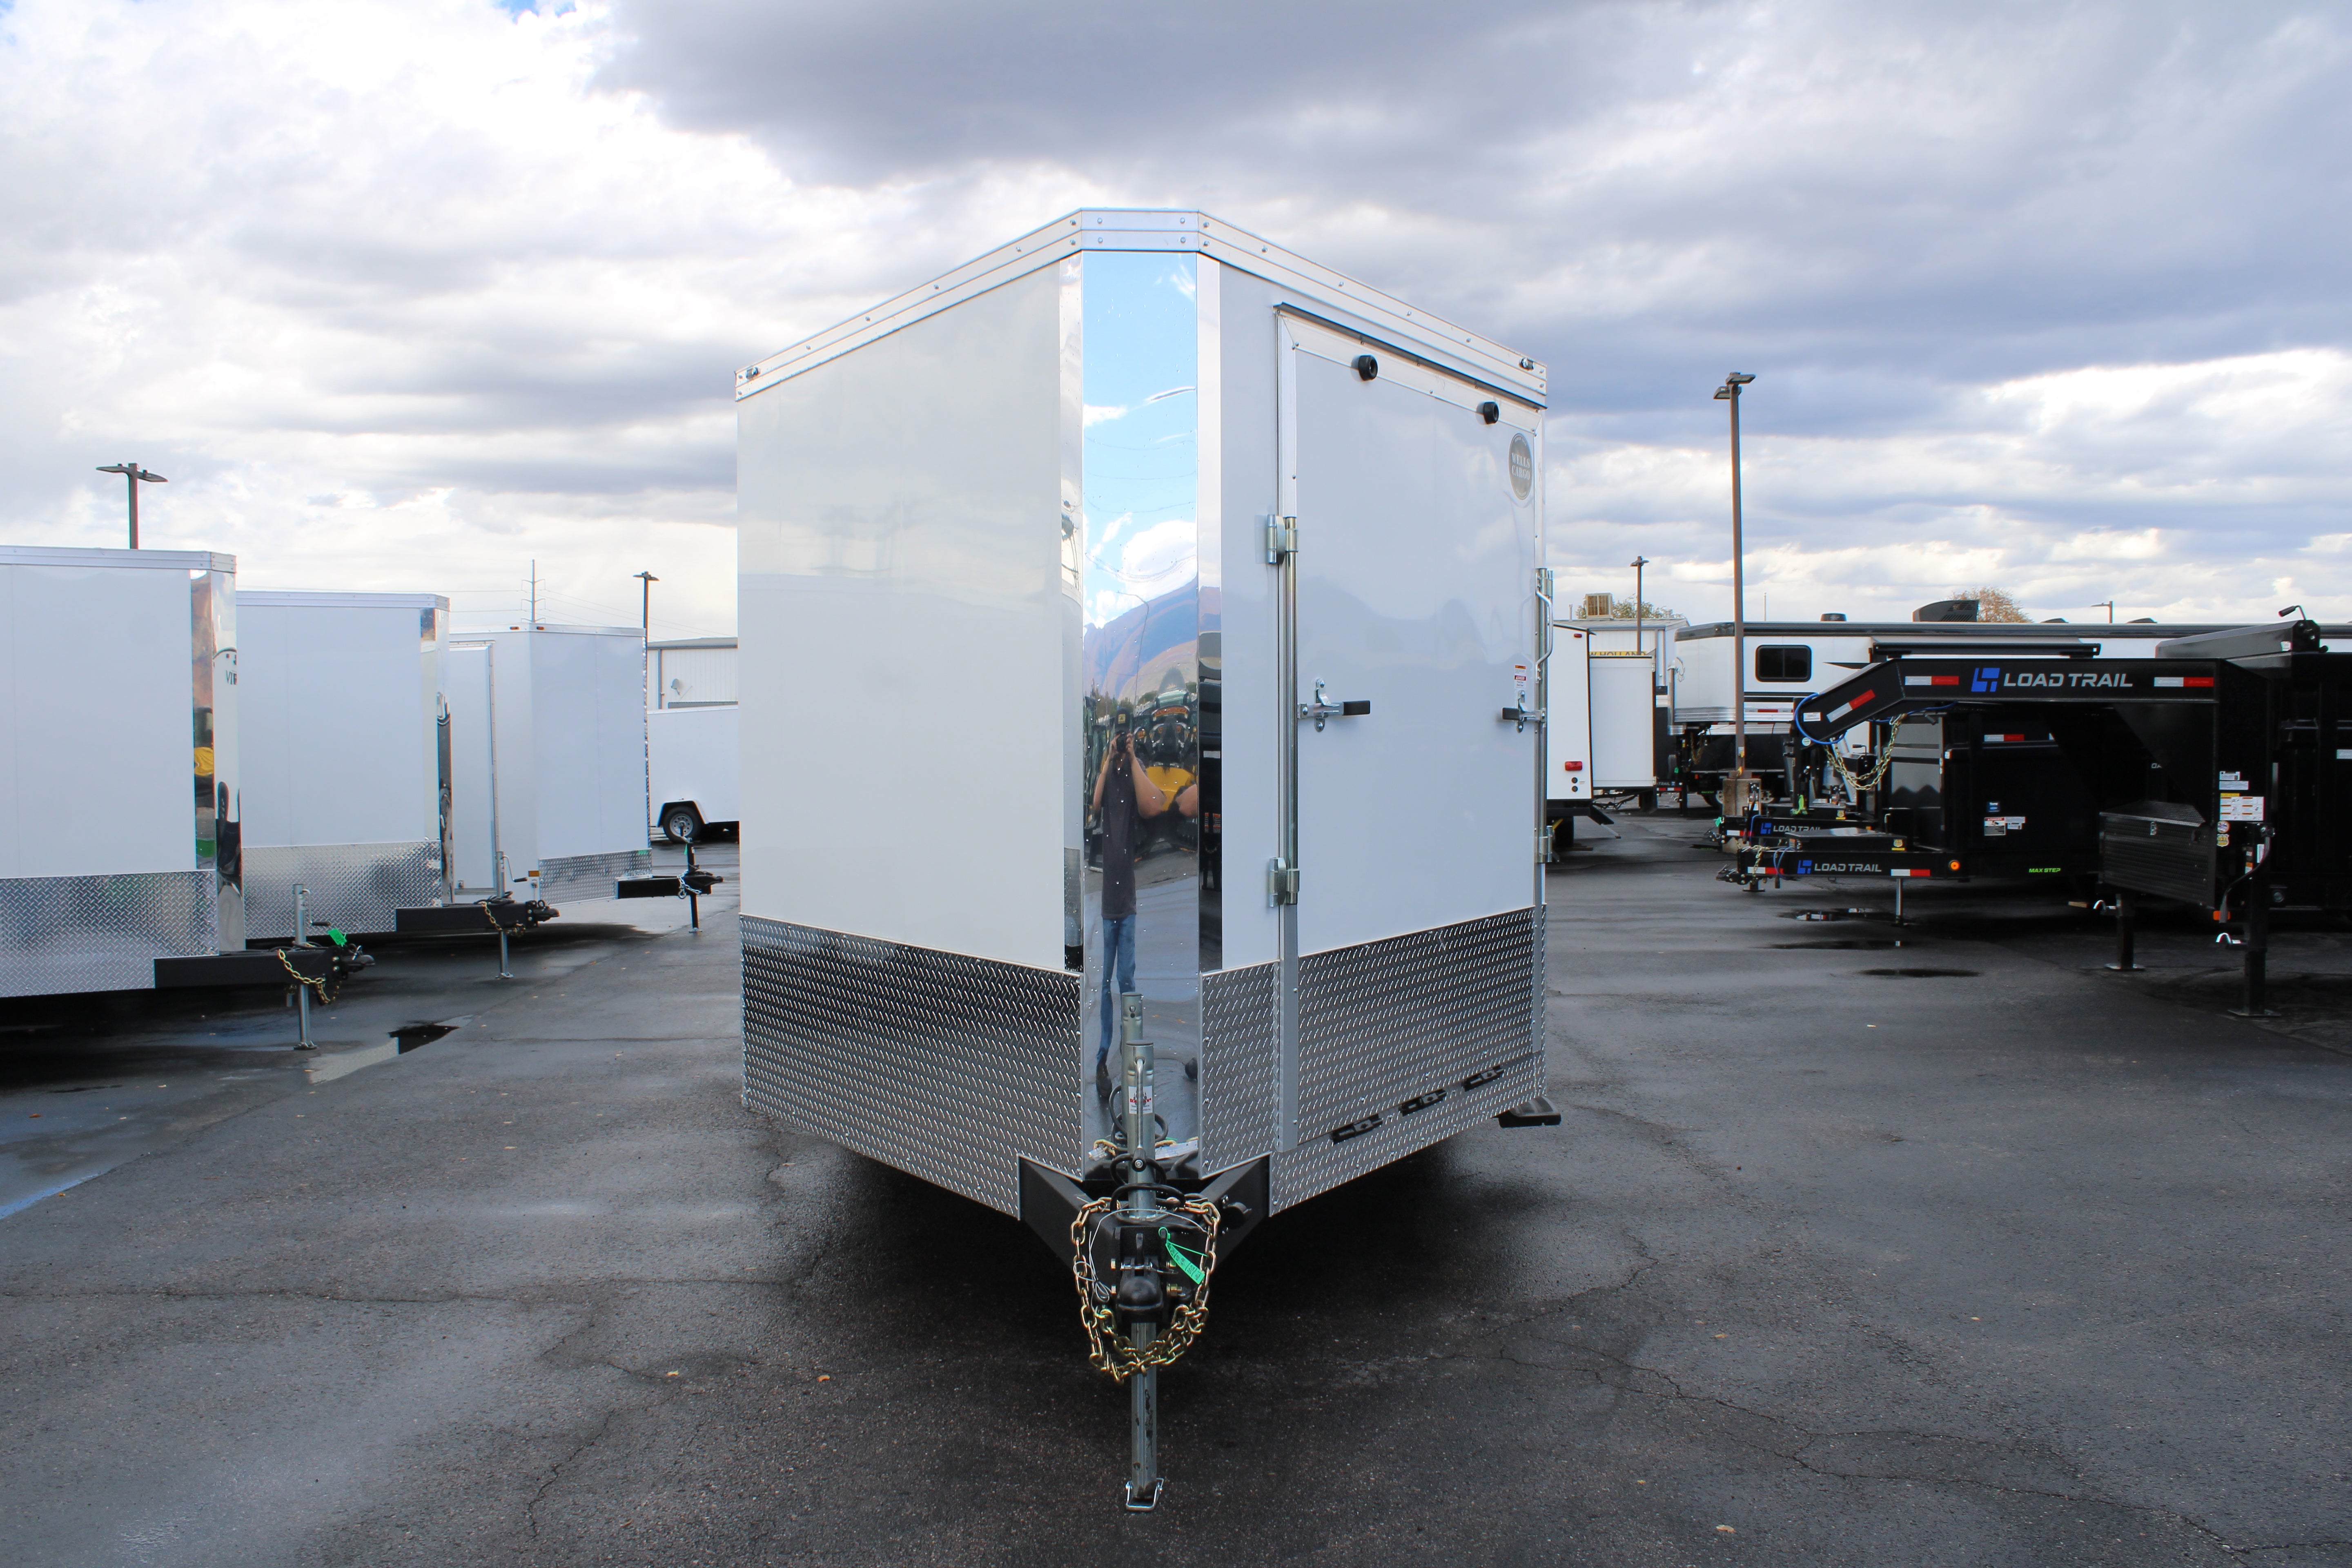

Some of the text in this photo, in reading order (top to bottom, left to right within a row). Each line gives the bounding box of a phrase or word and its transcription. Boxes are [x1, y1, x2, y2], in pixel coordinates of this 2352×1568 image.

[1512, 452, 1530, 468] WELLS
[1512, 465, 1530, 480] CARGO
[2004, 673, 2133, 687] LOAD TRAIL
[1814, 863, 1882, 872] LOAD TRAIL
